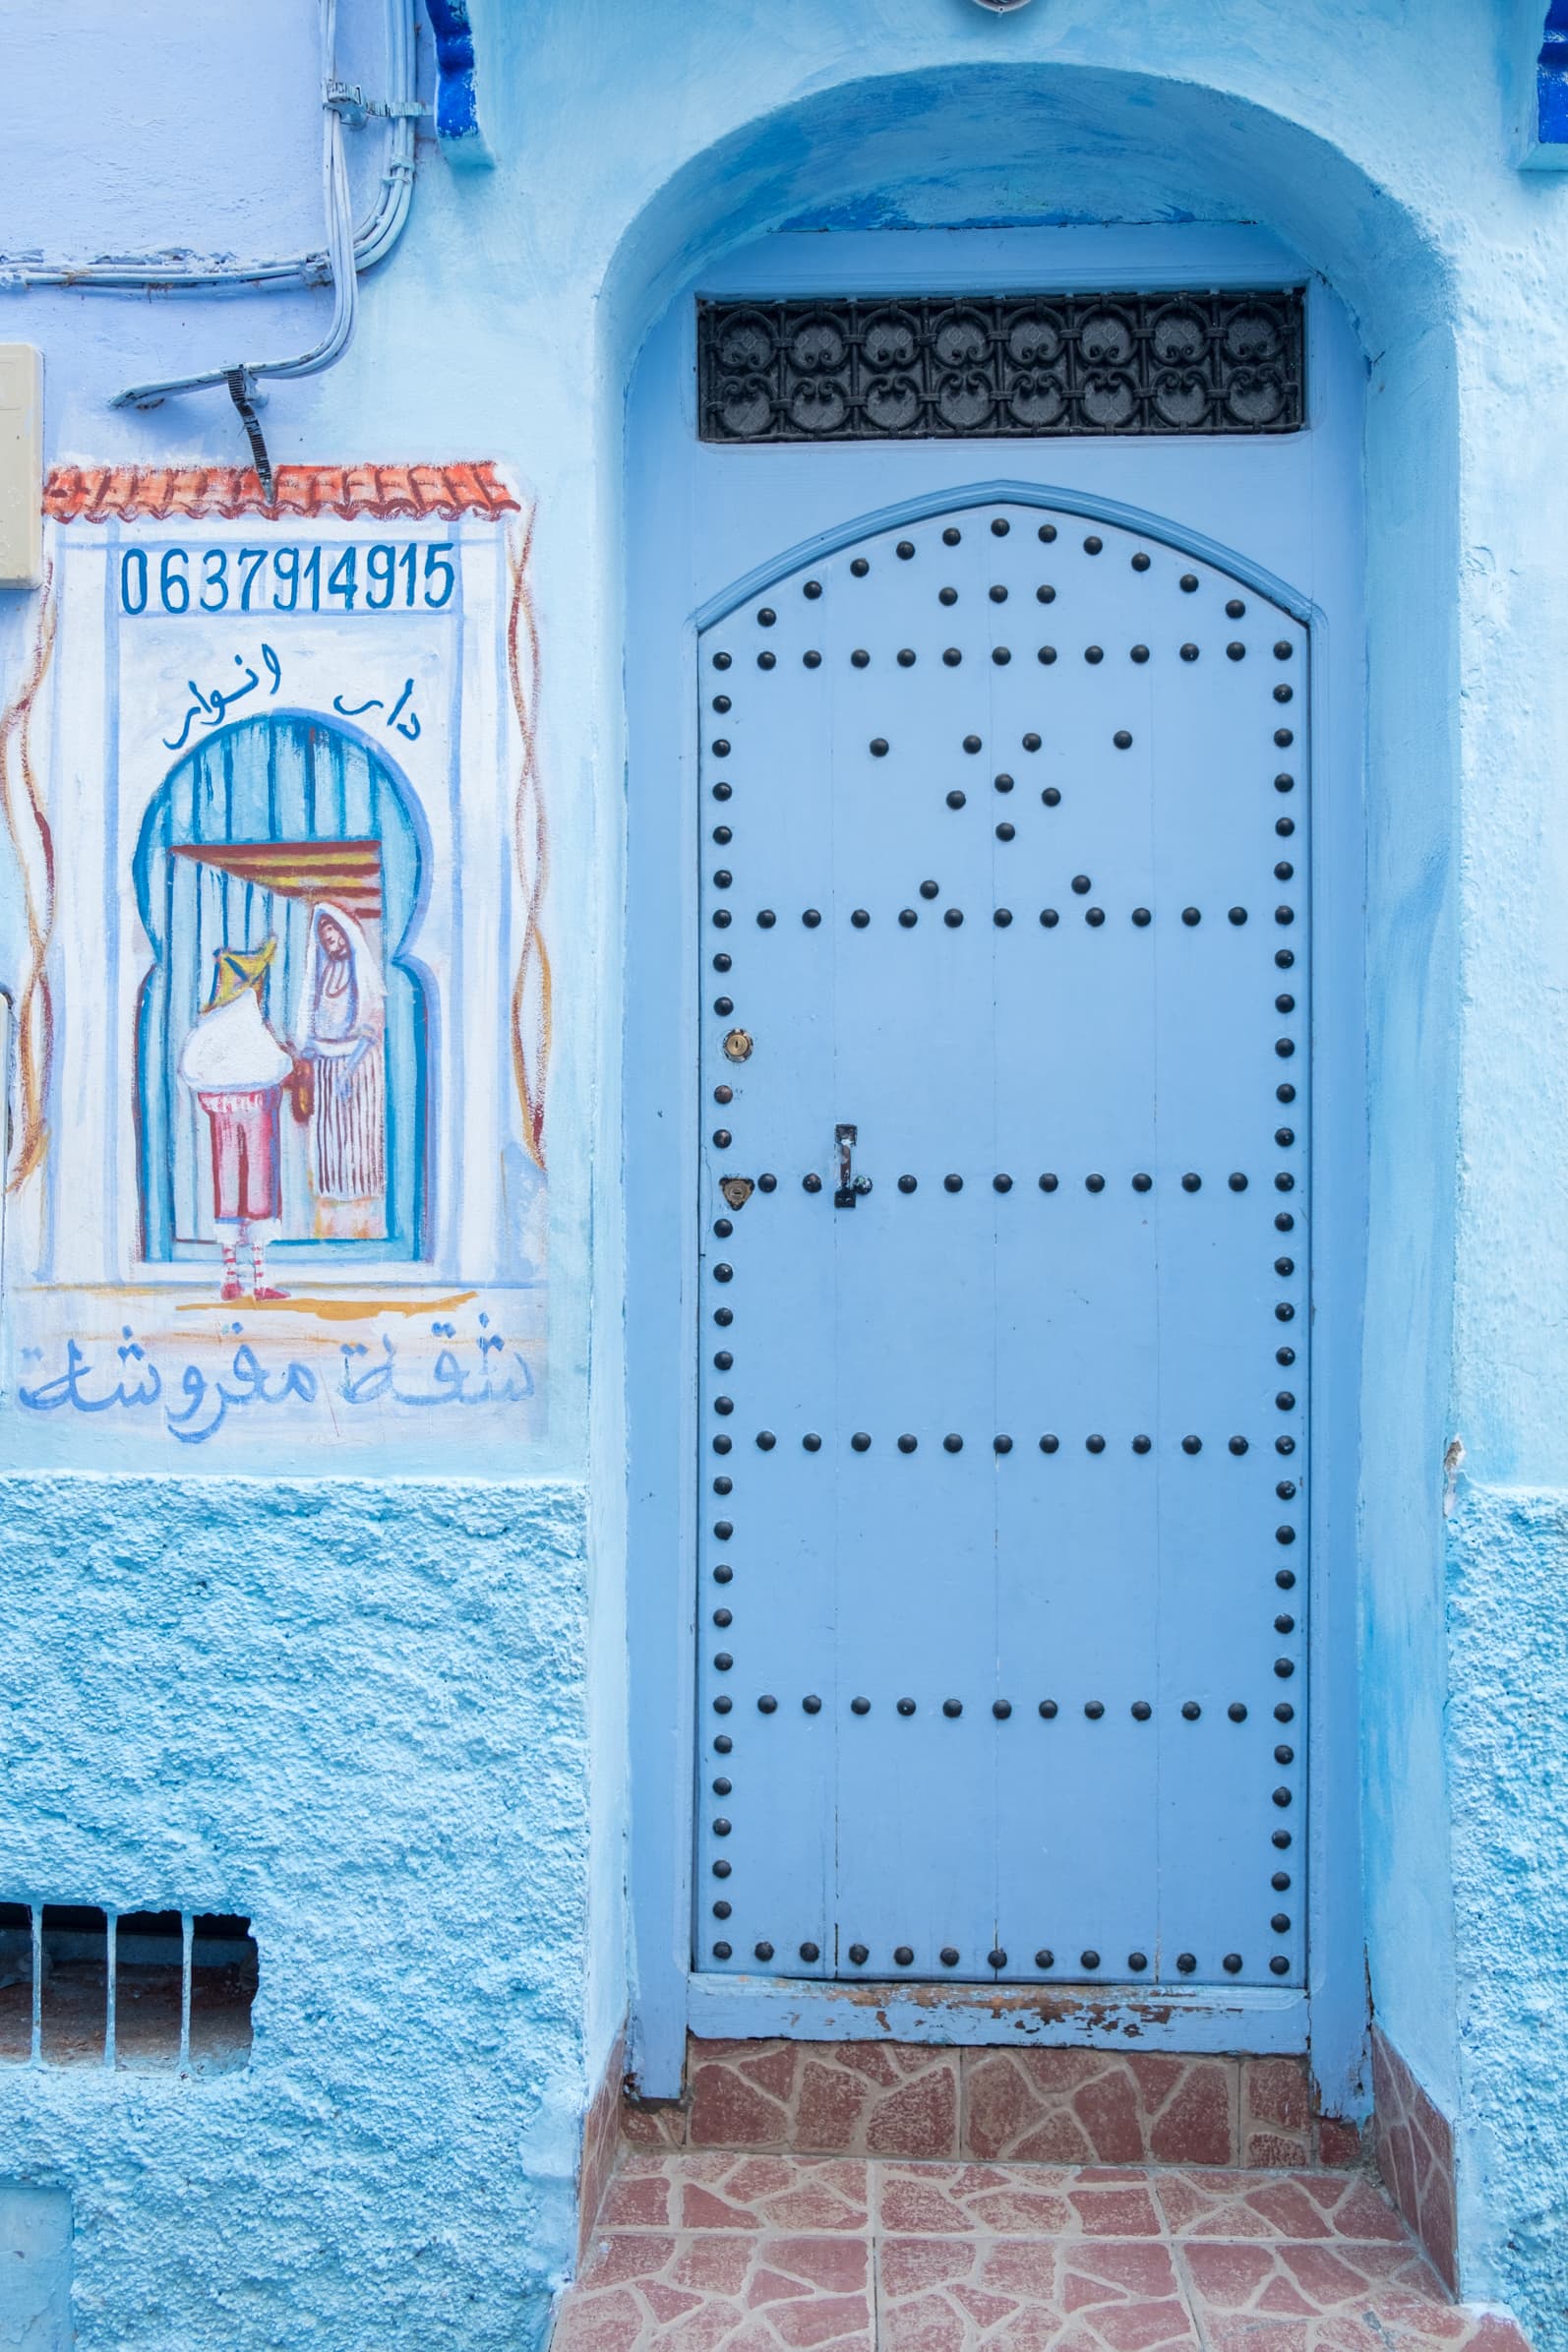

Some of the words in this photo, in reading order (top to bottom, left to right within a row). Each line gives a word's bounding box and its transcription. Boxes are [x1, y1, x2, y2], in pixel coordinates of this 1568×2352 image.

[121, 543, 455, 615] 0637914915
[333, 678, 422, 742] دار
[19, 1323, 319, 1444] مفروشة
[339, 1311, 536, 1406] شقة
